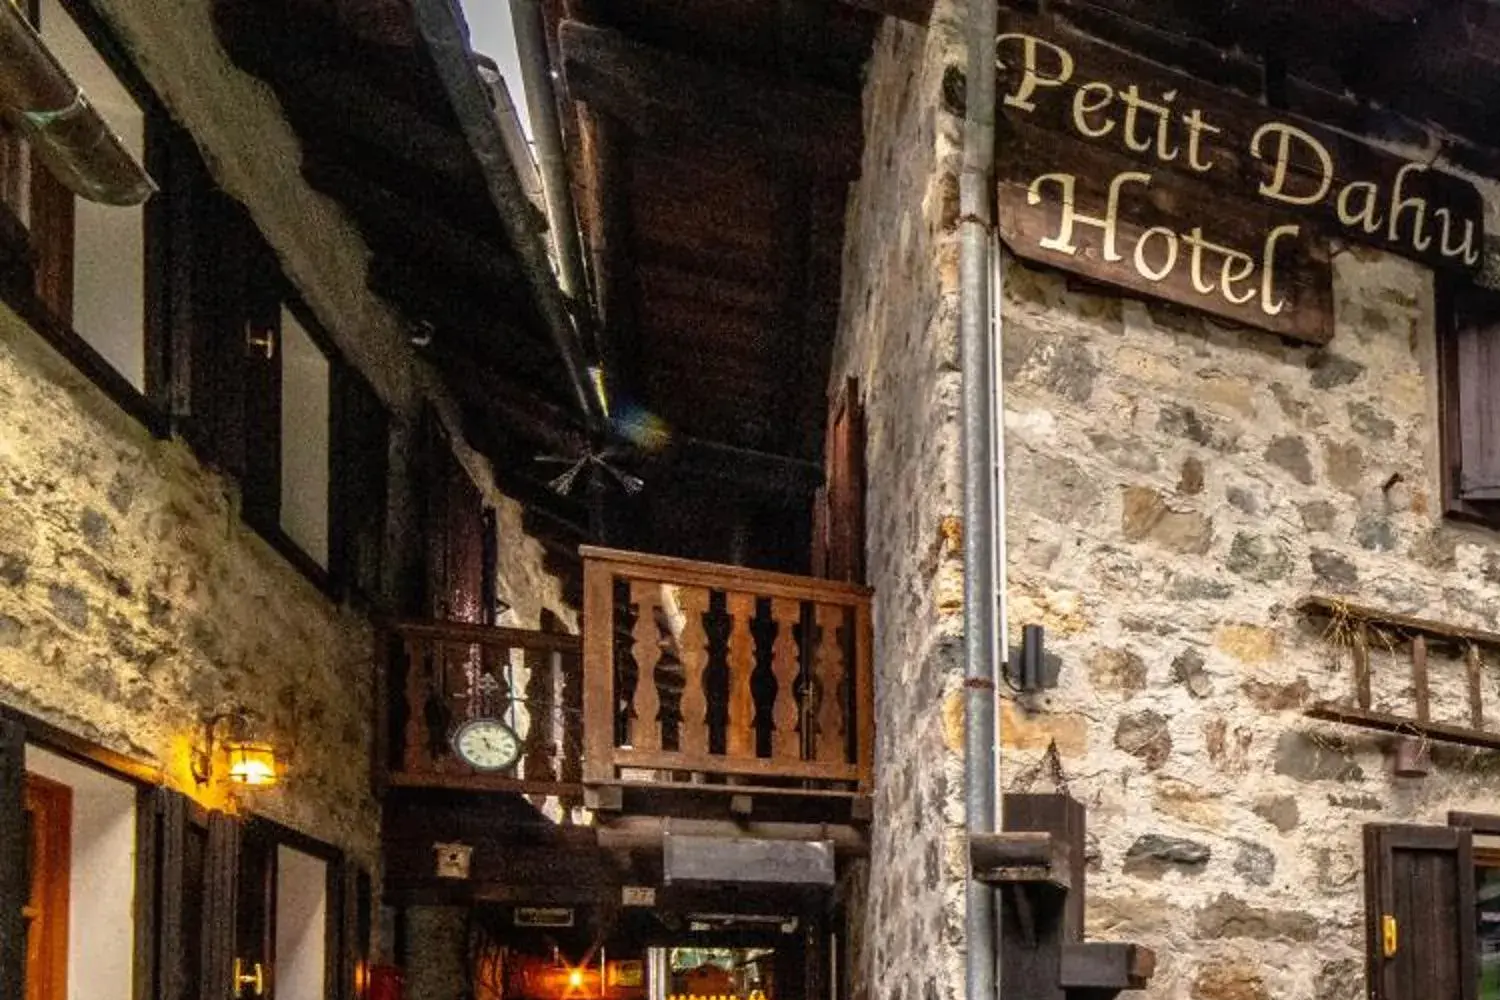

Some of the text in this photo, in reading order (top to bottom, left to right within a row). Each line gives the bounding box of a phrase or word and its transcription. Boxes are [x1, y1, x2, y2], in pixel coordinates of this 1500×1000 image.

[995, 32, 1479, 265] Petit Dahu
[1027, 172, 1299, 316] Hotel
